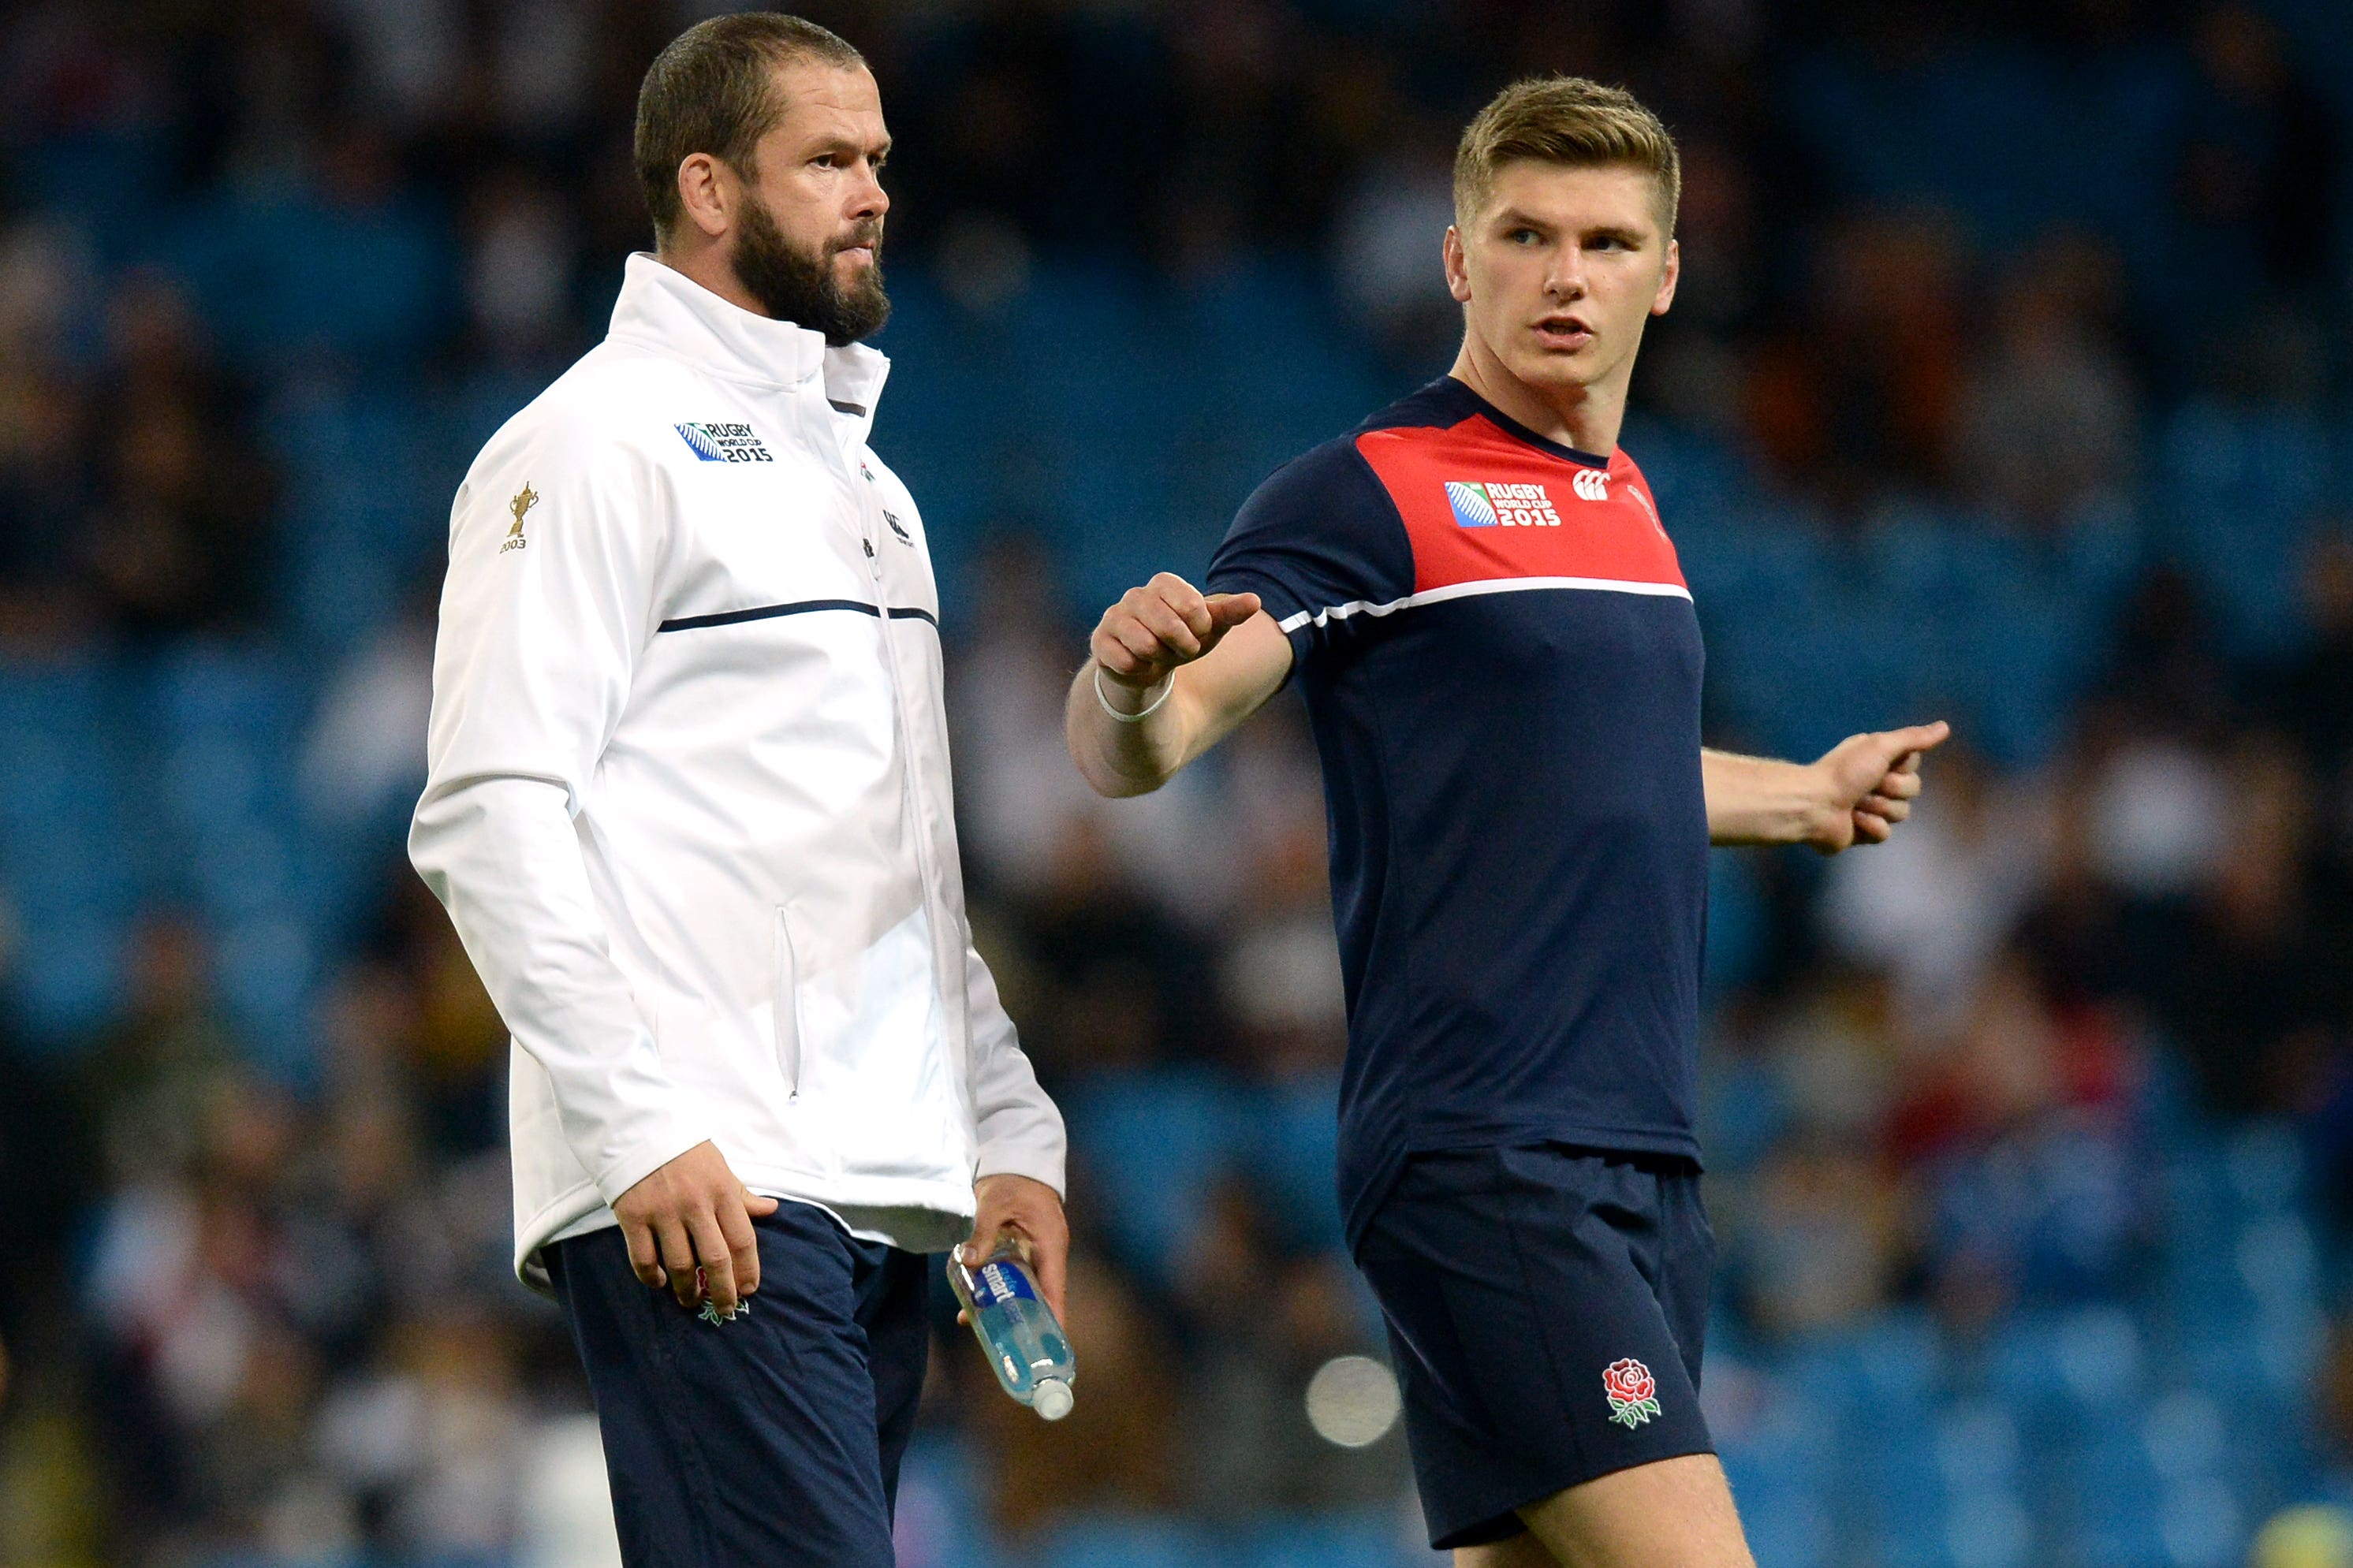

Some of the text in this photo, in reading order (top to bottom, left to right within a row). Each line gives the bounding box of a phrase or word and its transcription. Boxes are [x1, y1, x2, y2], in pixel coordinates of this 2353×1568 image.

[705, 423, 755, 438] RUGBY
[715, 438, 748, 447] WORLD
[722, 448, 774, 463] 2015
[1484, 482, 1546, 501] RUGBY
[1492, 499, 1553, 509] WORLD CUP
[1497, 508, 1562, 527] 2015
[499, 539, 527, 554] 2003
